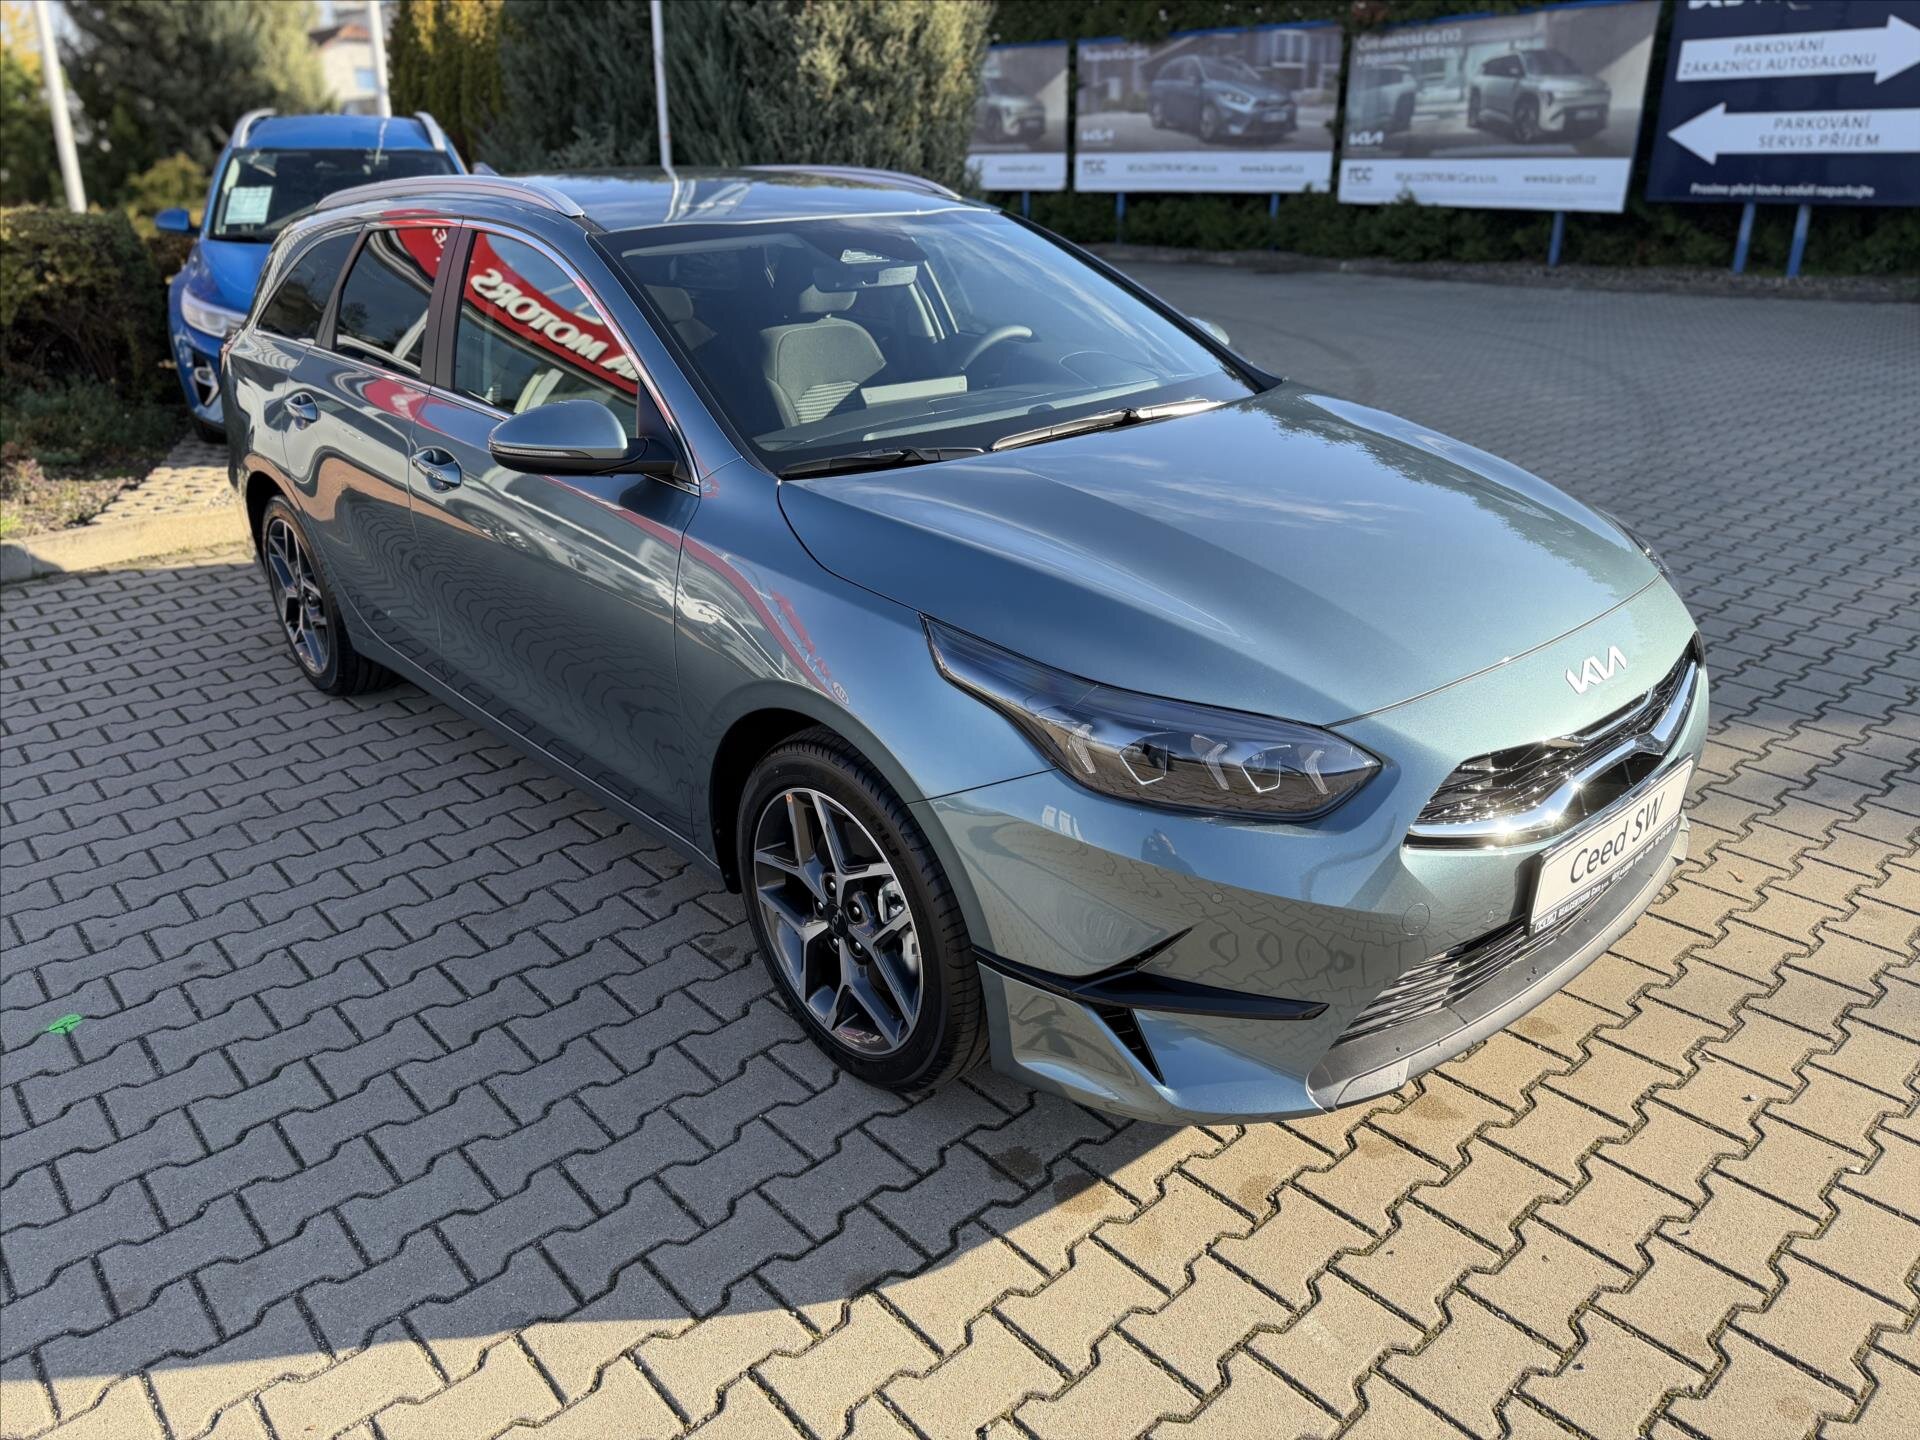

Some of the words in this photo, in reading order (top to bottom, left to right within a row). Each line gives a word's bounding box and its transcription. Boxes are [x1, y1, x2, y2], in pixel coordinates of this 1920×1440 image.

[1733, 38, 1825, 55] PARKOVÁNÍ
[1682, 57, 1762, 75] ZÁKAZNÍCI
[1766, 53, 1877, 71] AUTOSALONU
[1773, 114, 1872, 131] PARKOVÁNÍ
[1758, 134, 1814, 149] SERVIS
[1818, 132, 1880, 148] PŘÍJEM
[1565, 645, 1628, 695] KIA
[1570, 820, 1630, 884] Ceed
[1632, 791, 1664, 843] SW
